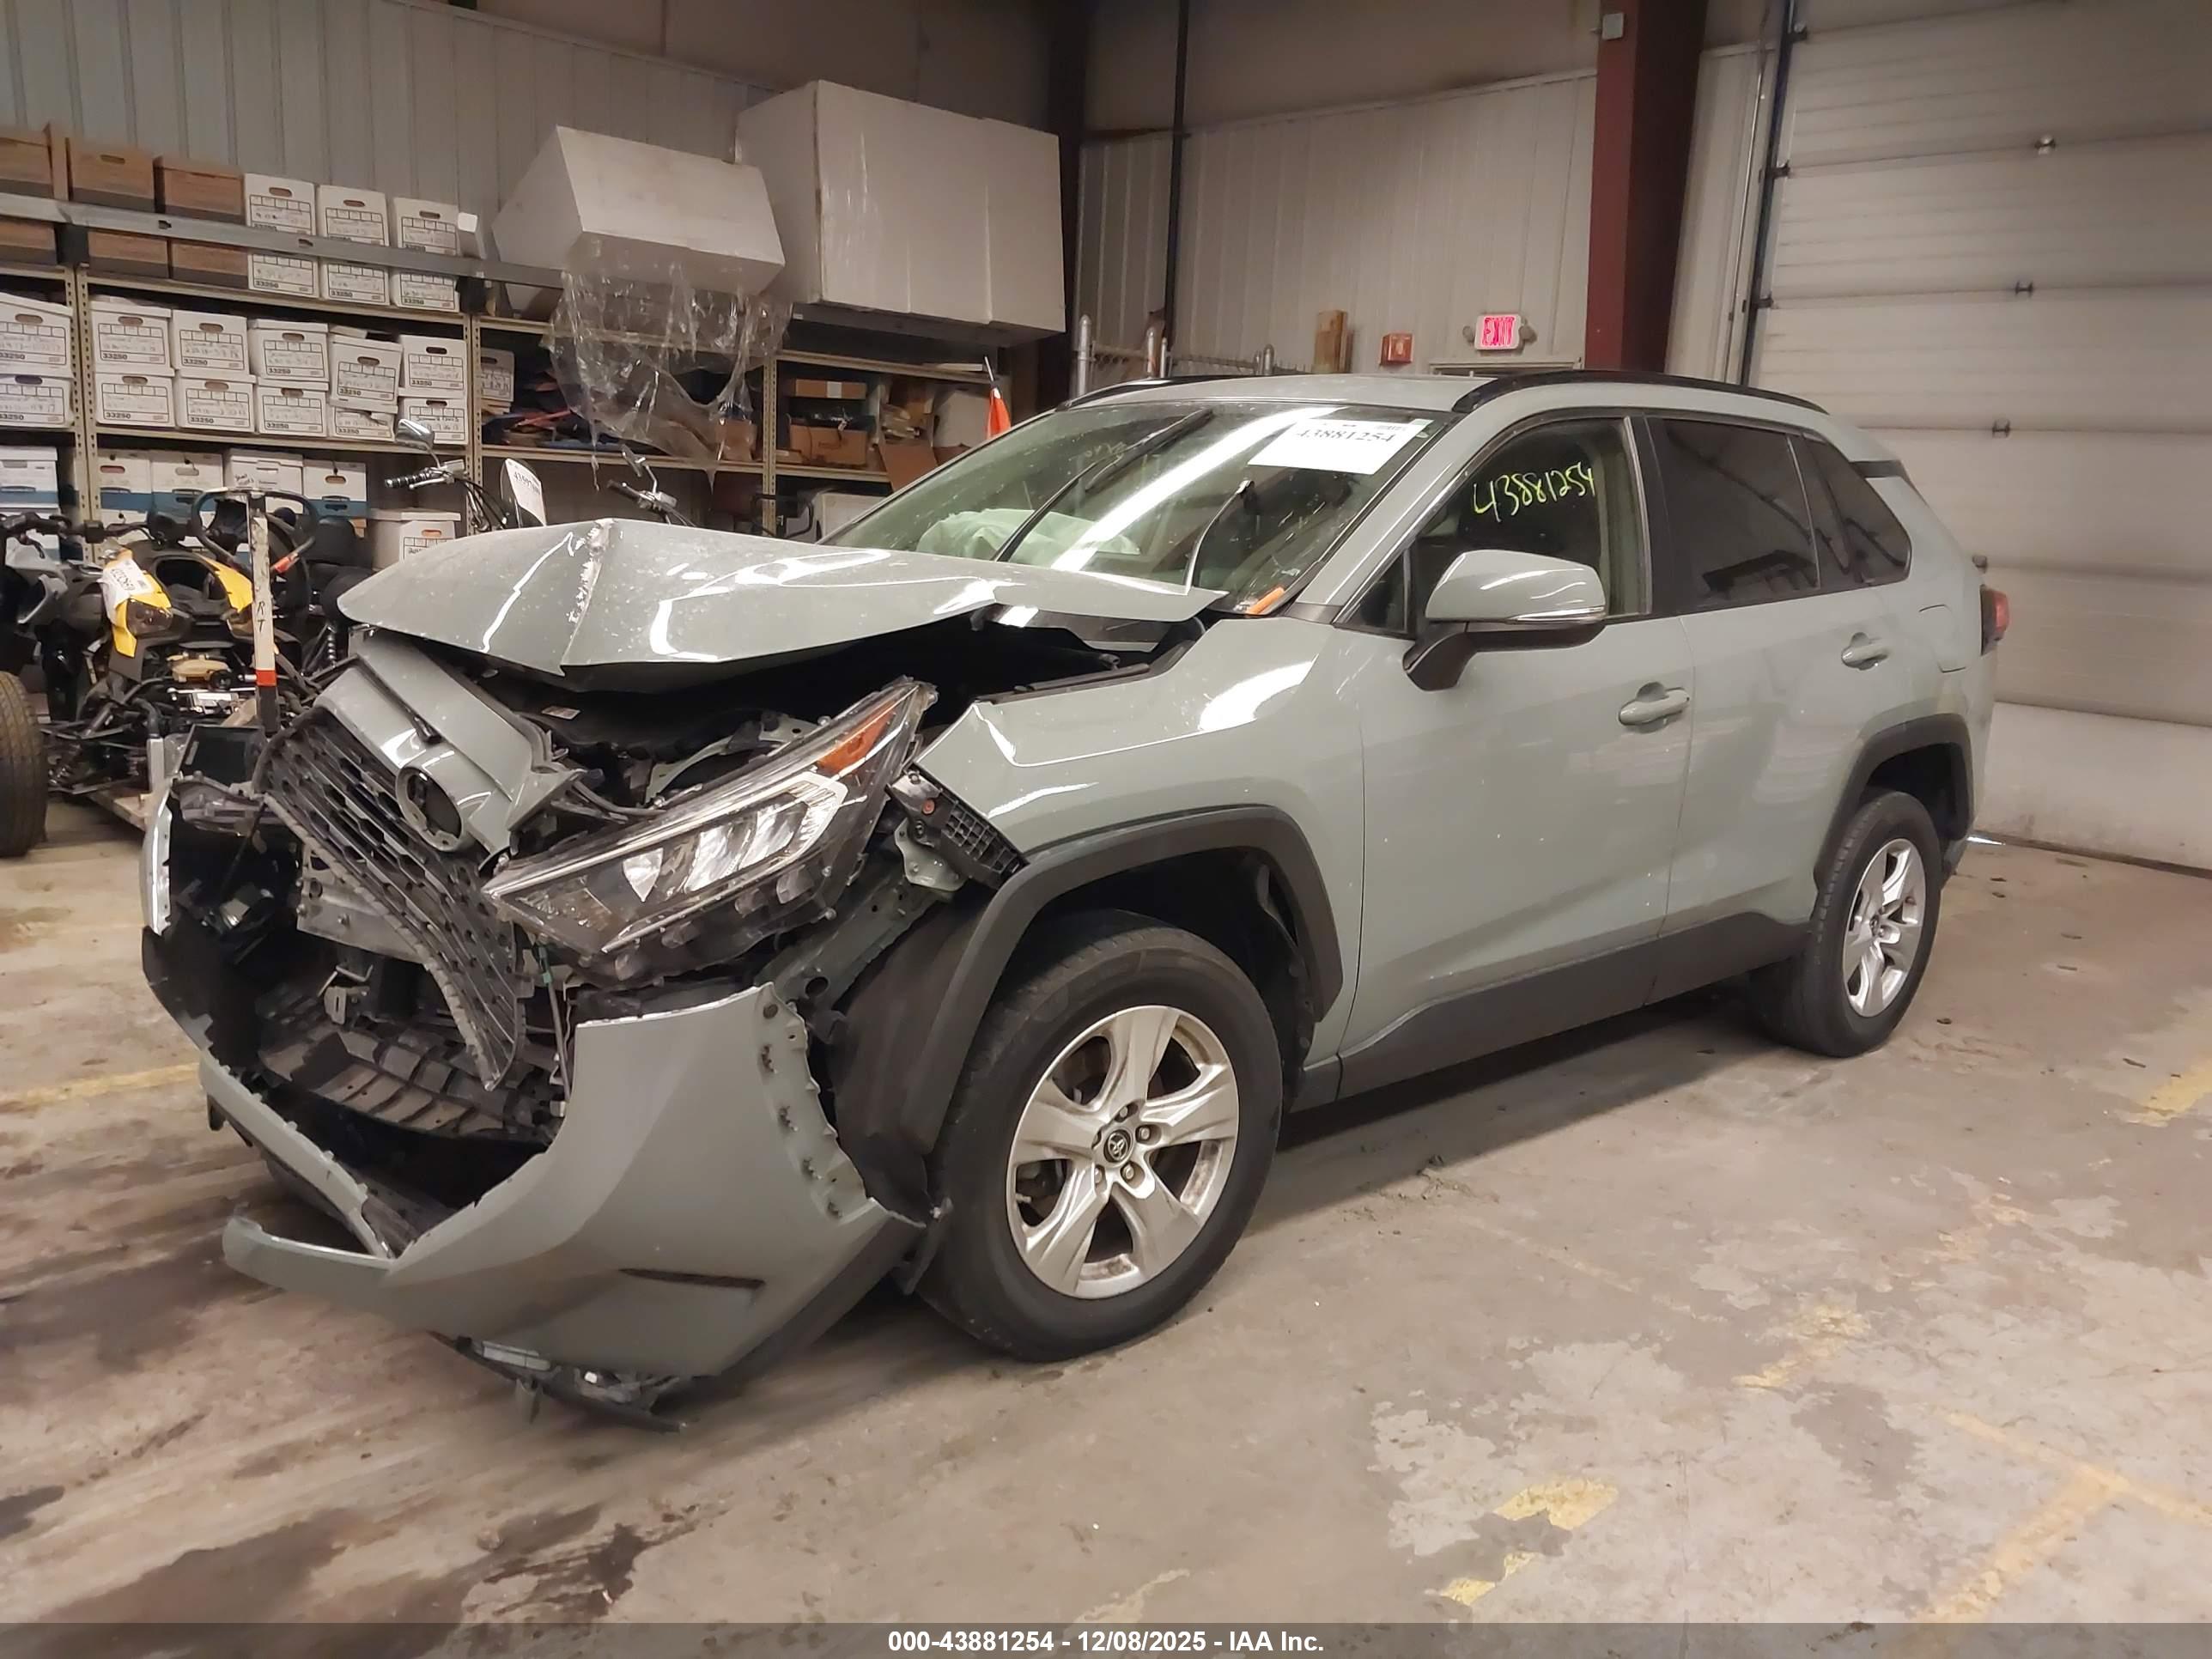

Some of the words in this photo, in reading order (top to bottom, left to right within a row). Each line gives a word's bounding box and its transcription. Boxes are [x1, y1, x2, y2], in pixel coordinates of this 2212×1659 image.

[1482, 316, 1515, 345] EXIT
[1296, 429, 1396, 442] 43881254
[1473, 462, 1595, 522] 43881254
